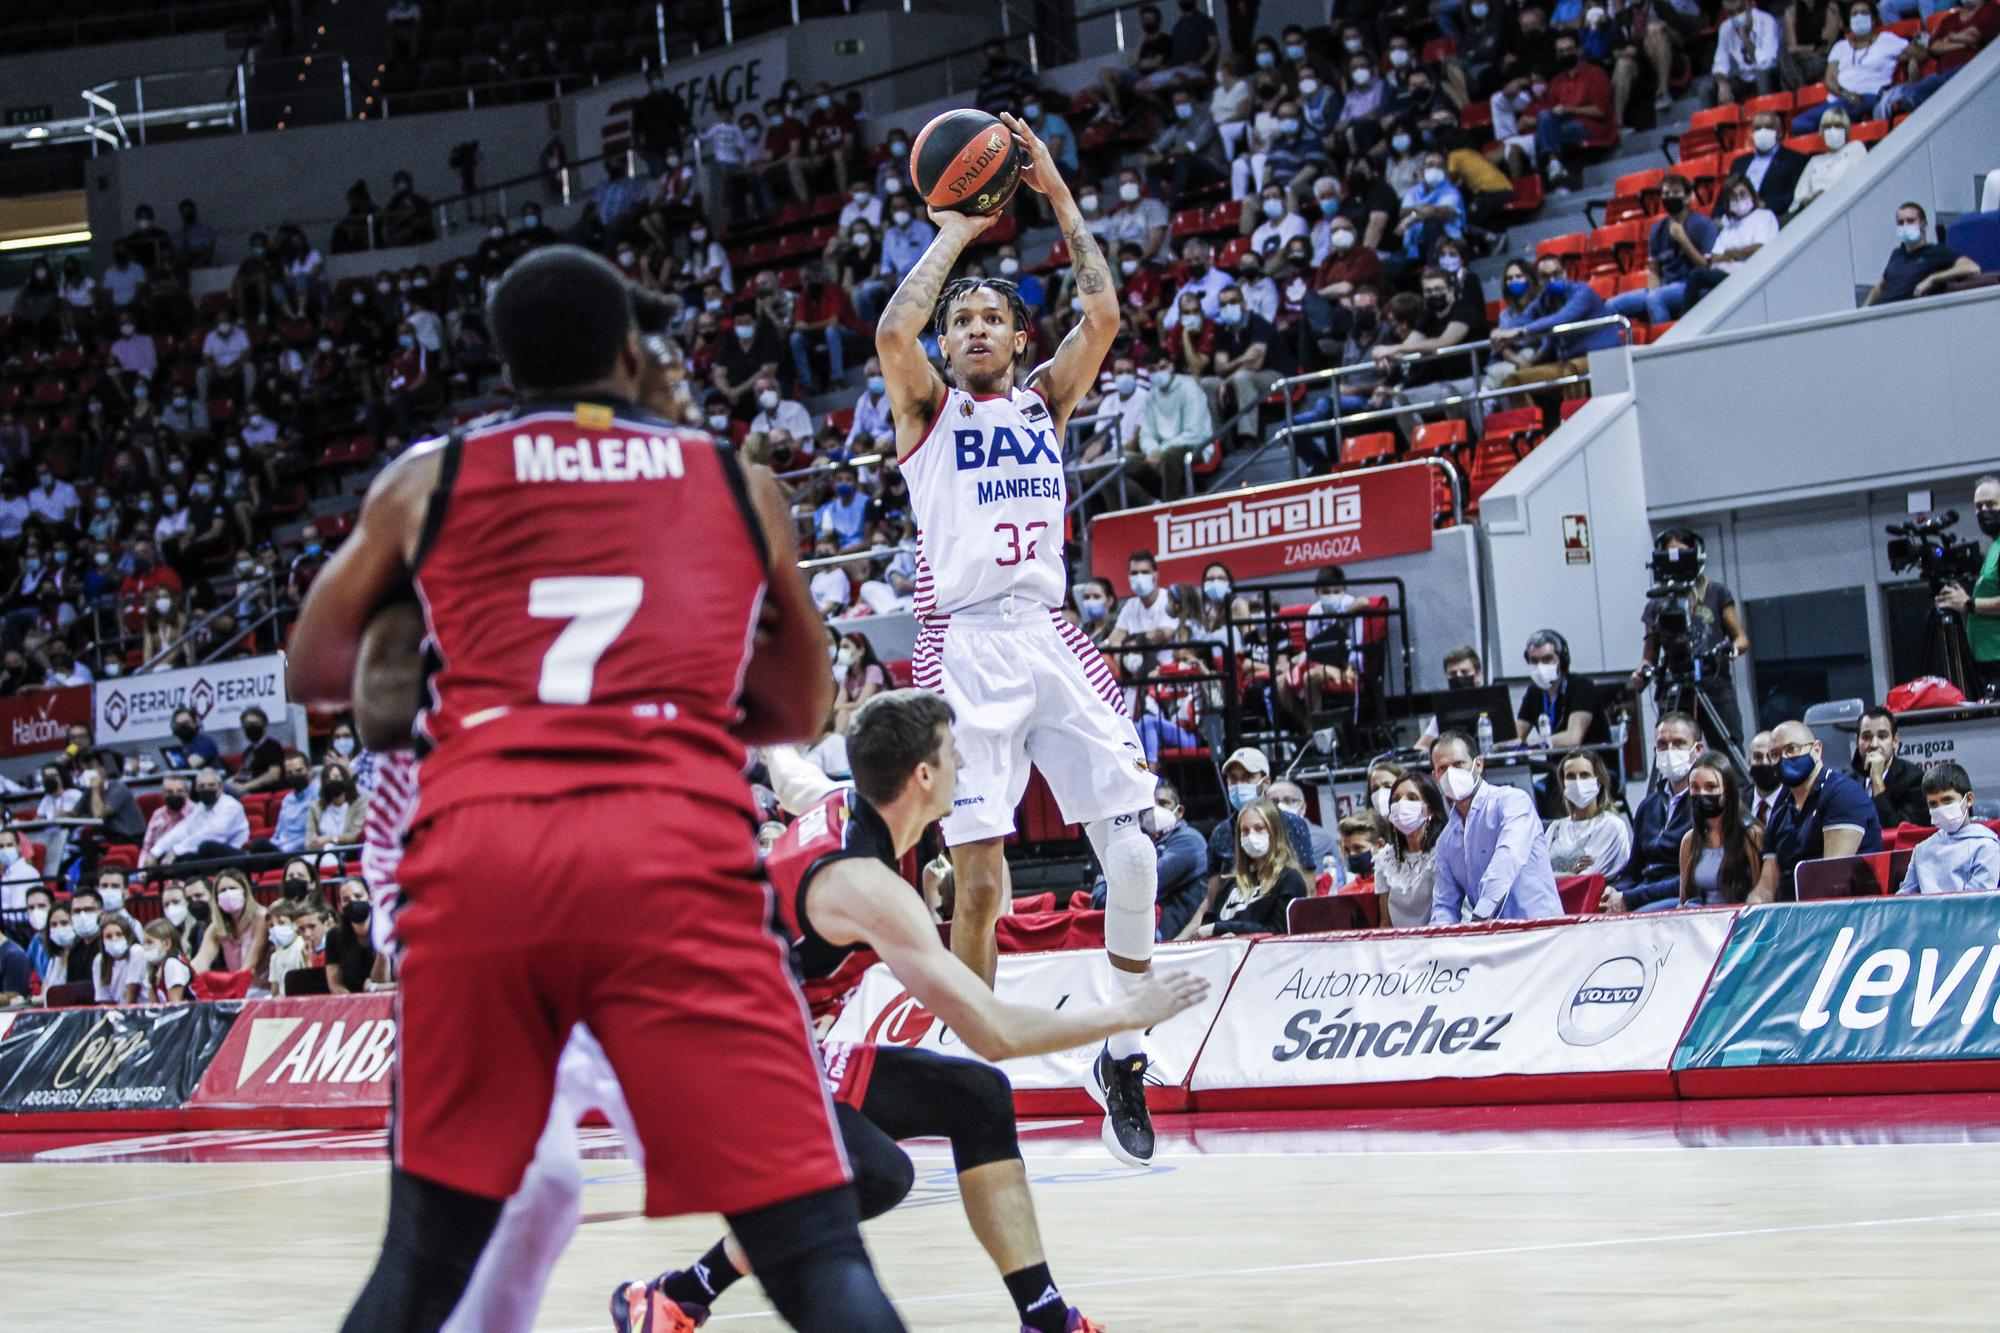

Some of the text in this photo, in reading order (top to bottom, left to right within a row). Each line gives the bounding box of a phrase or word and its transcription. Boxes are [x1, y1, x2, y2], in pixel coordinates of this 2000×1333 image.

[946, 132, 1007, 198] SPALDING
[513, 434, 685, 483] McLEAN
[977, 477, 1061, 506] MANRESA
[994, 521, 1048, 567] 32
[1284, 536, 1361, 566] ZARAGOZA
[527, 575, 644, 705] 7
[130, 687, 186, 714] FERRUZ
[217, 674, 276, 701] FERRUZ
[1897, 740, 1954, 758] Zaragoza
[1276, 960, 1470, 1000] Automóviles
[1579, 988, 1638, 1003] VOLVO
[1799, 926, 2000, 1030] levi
[1271, 1005, 1513, 1062] Sánchez
